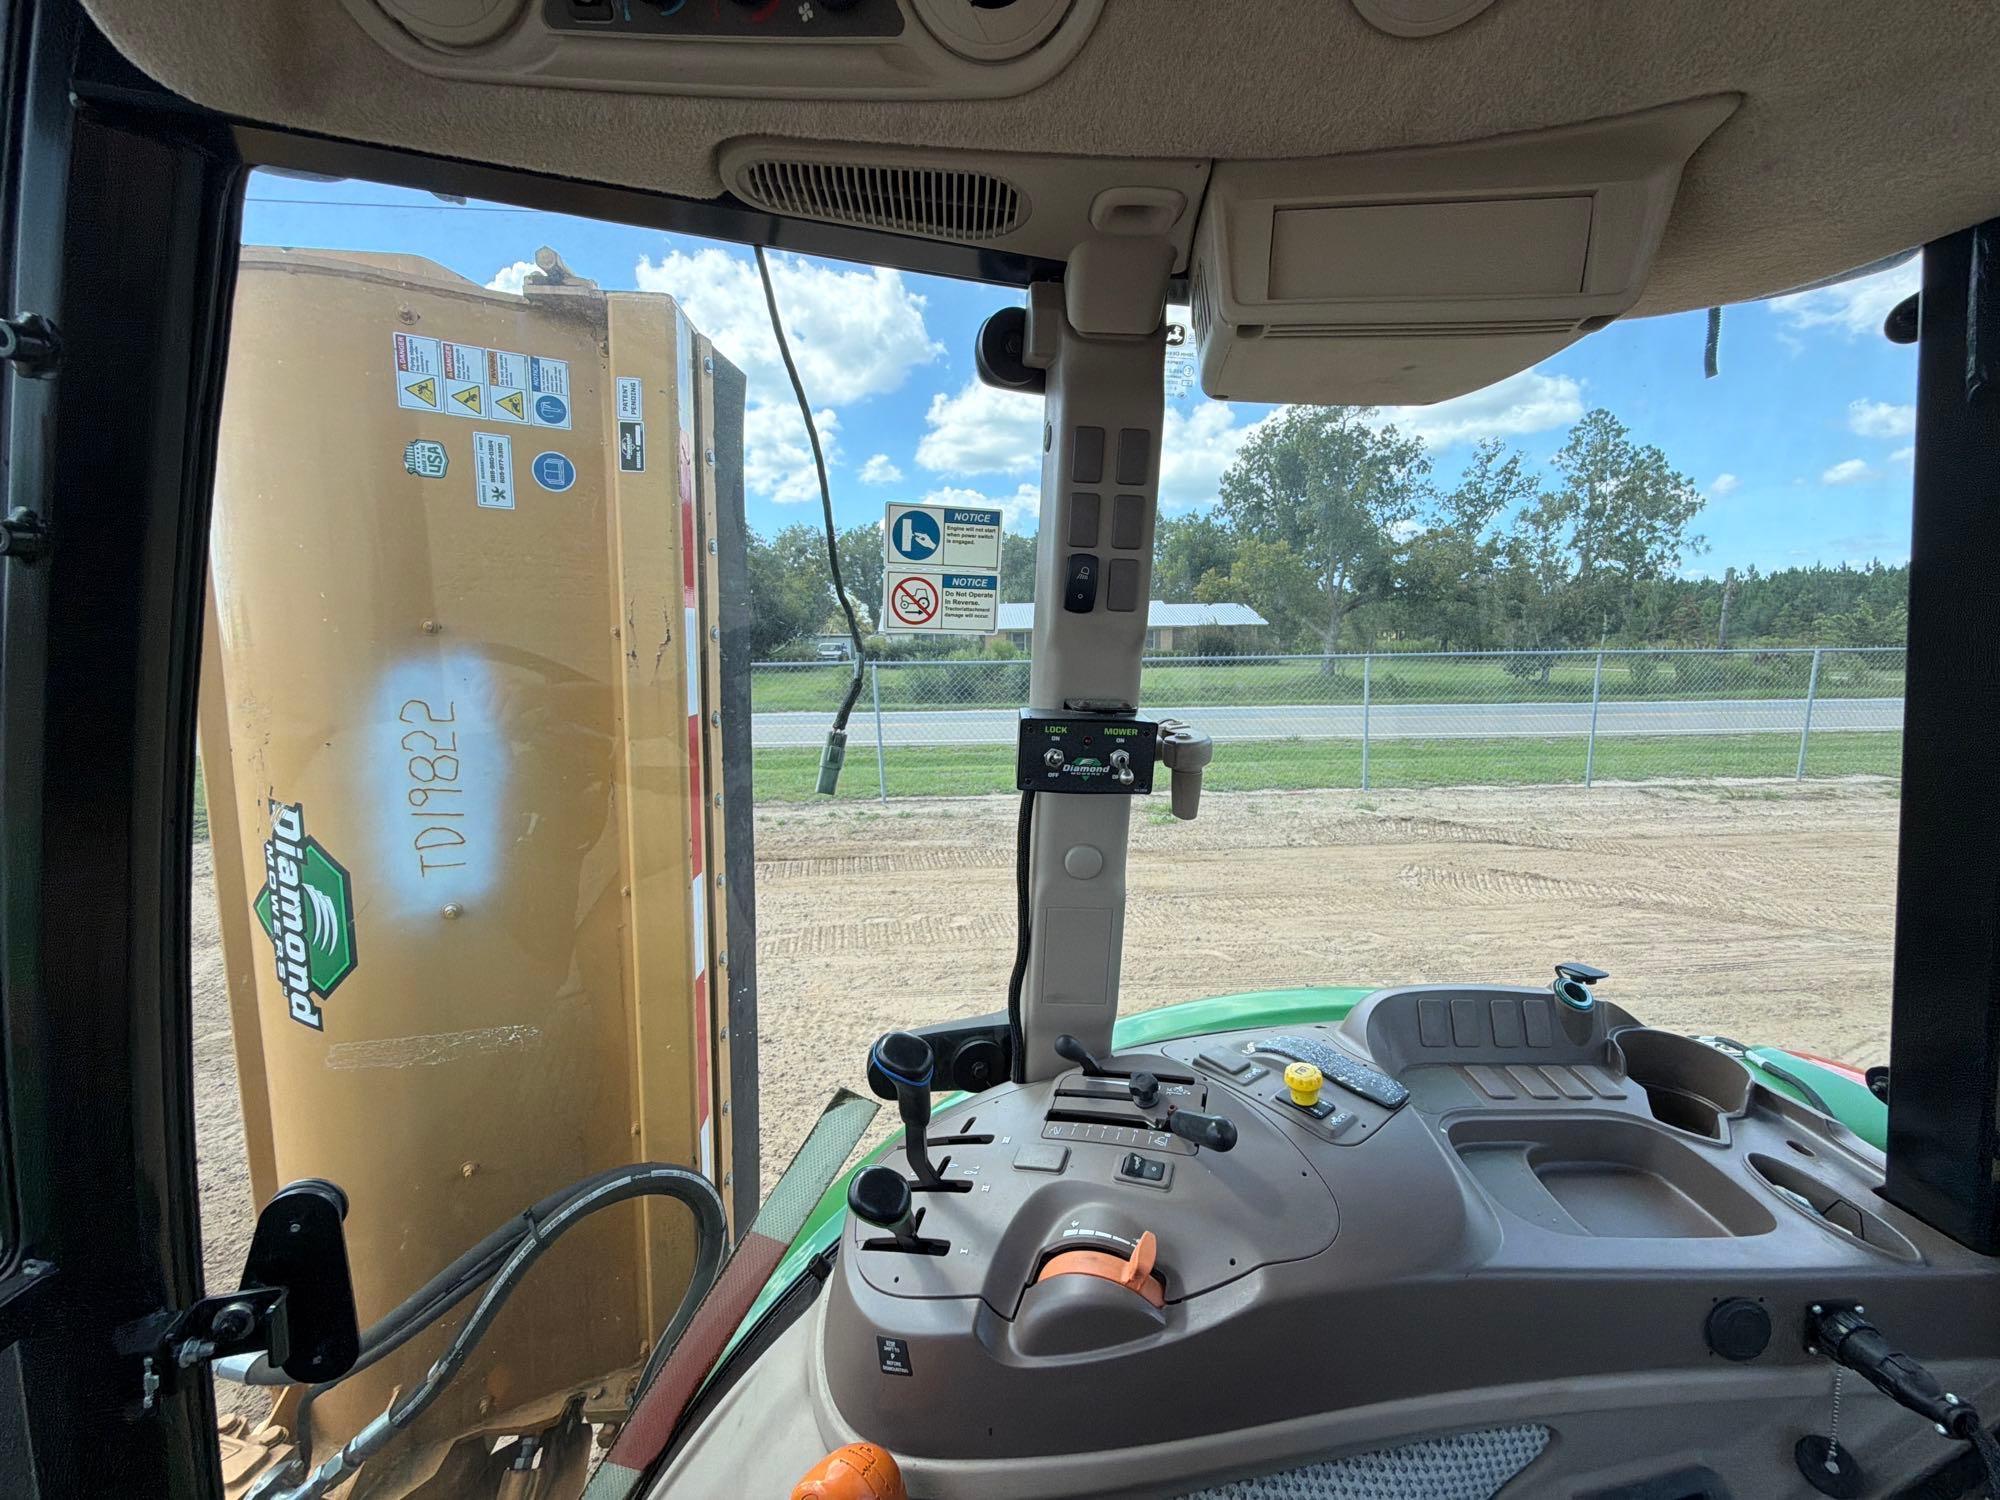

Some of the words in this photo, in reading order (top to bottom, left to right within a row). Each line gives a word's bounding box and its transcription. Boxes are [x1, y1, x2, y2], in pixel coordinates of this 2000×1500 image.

[397, 335, 407, 364] DANGER
[426, 446, 444, 473] USA
[954, 513, 991, 523] NOTICE
[952, 578, 988, 587] NOTICE
[969, 591, 993, 599] Operate
[1044, 726, 1068, 734] LOCK
[1104, 727, 1138, 736] MOWER
[1062, 764, 1110, 773] Diamond
[399, 700, 468, 878] TD19822
[265, 842, 287, 980] MOWERS
[271, 804, 320, 1027] Diamond
